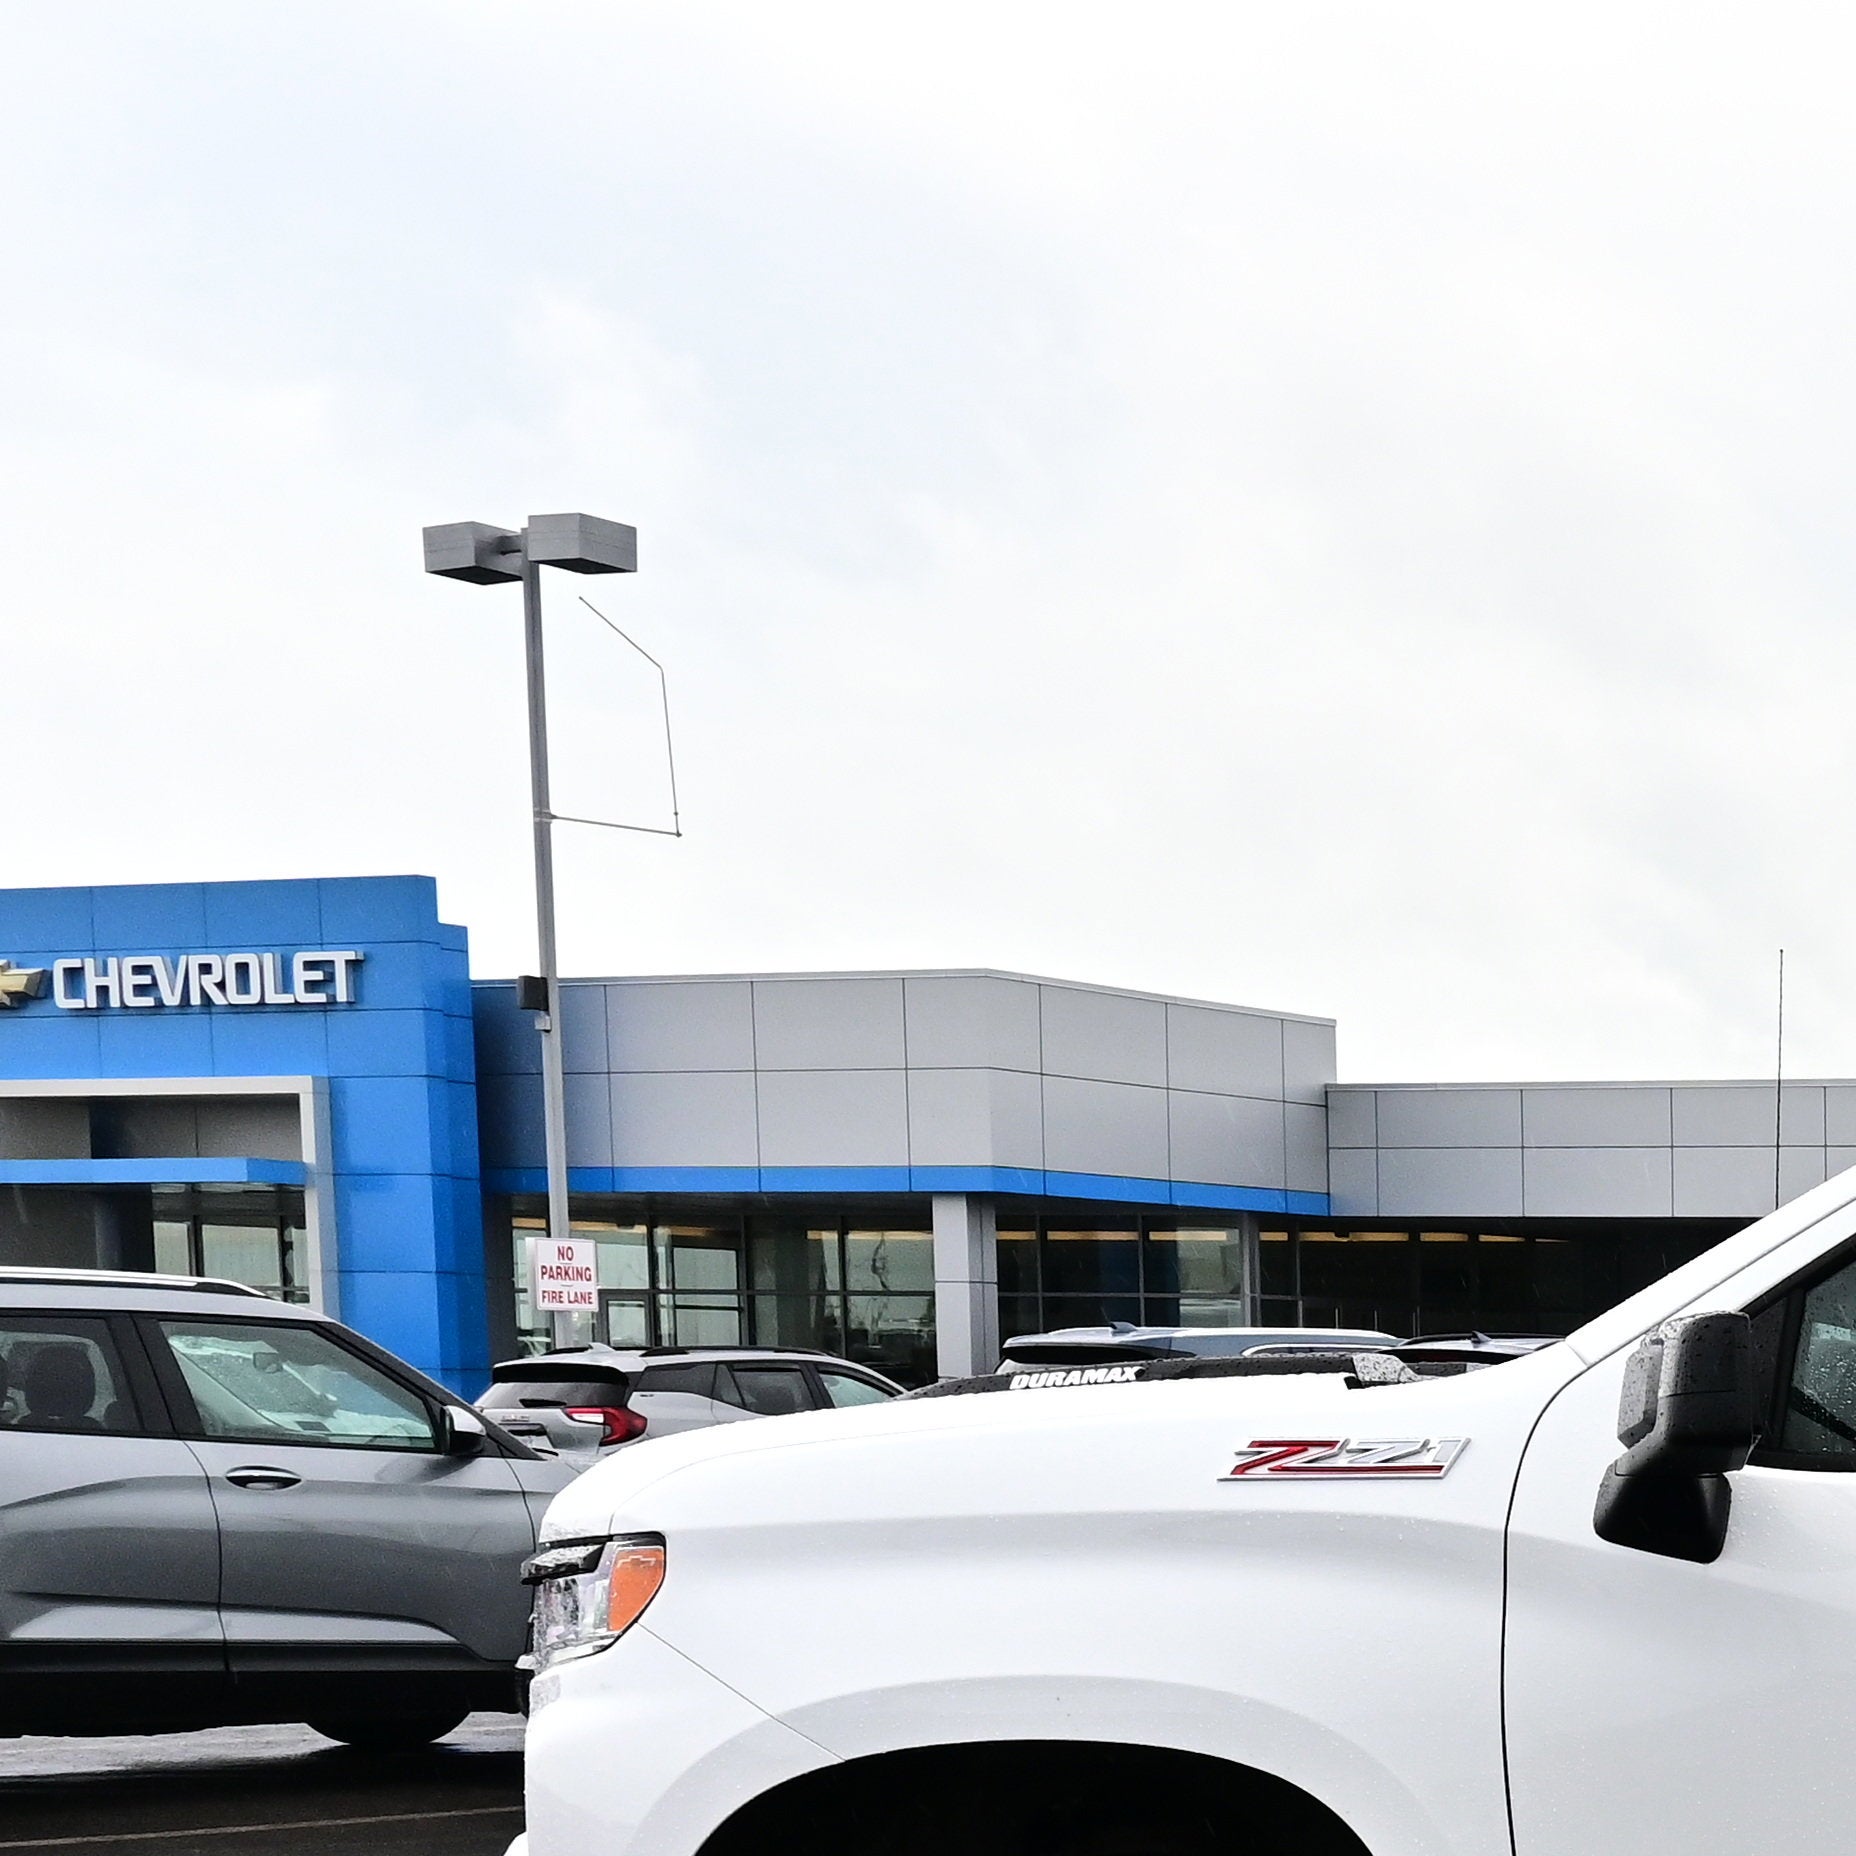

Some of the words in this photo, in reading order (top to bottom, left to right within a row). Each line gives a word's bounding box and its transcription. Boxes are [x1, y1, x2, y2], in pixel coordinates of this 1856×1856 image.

[53, 950, 359, 1010] CHEVROLET
[557, 1246, 574, 1261] NO
[540, 1264, 592, 1282] PARKING
[541, 1290, 564, 1304] FIRE
[567, 1291, 593, 1305] LANE
[1009, 1366, 1146, 1390] DURAMAX
[1217, 1437, 1471, 1481] Z71
